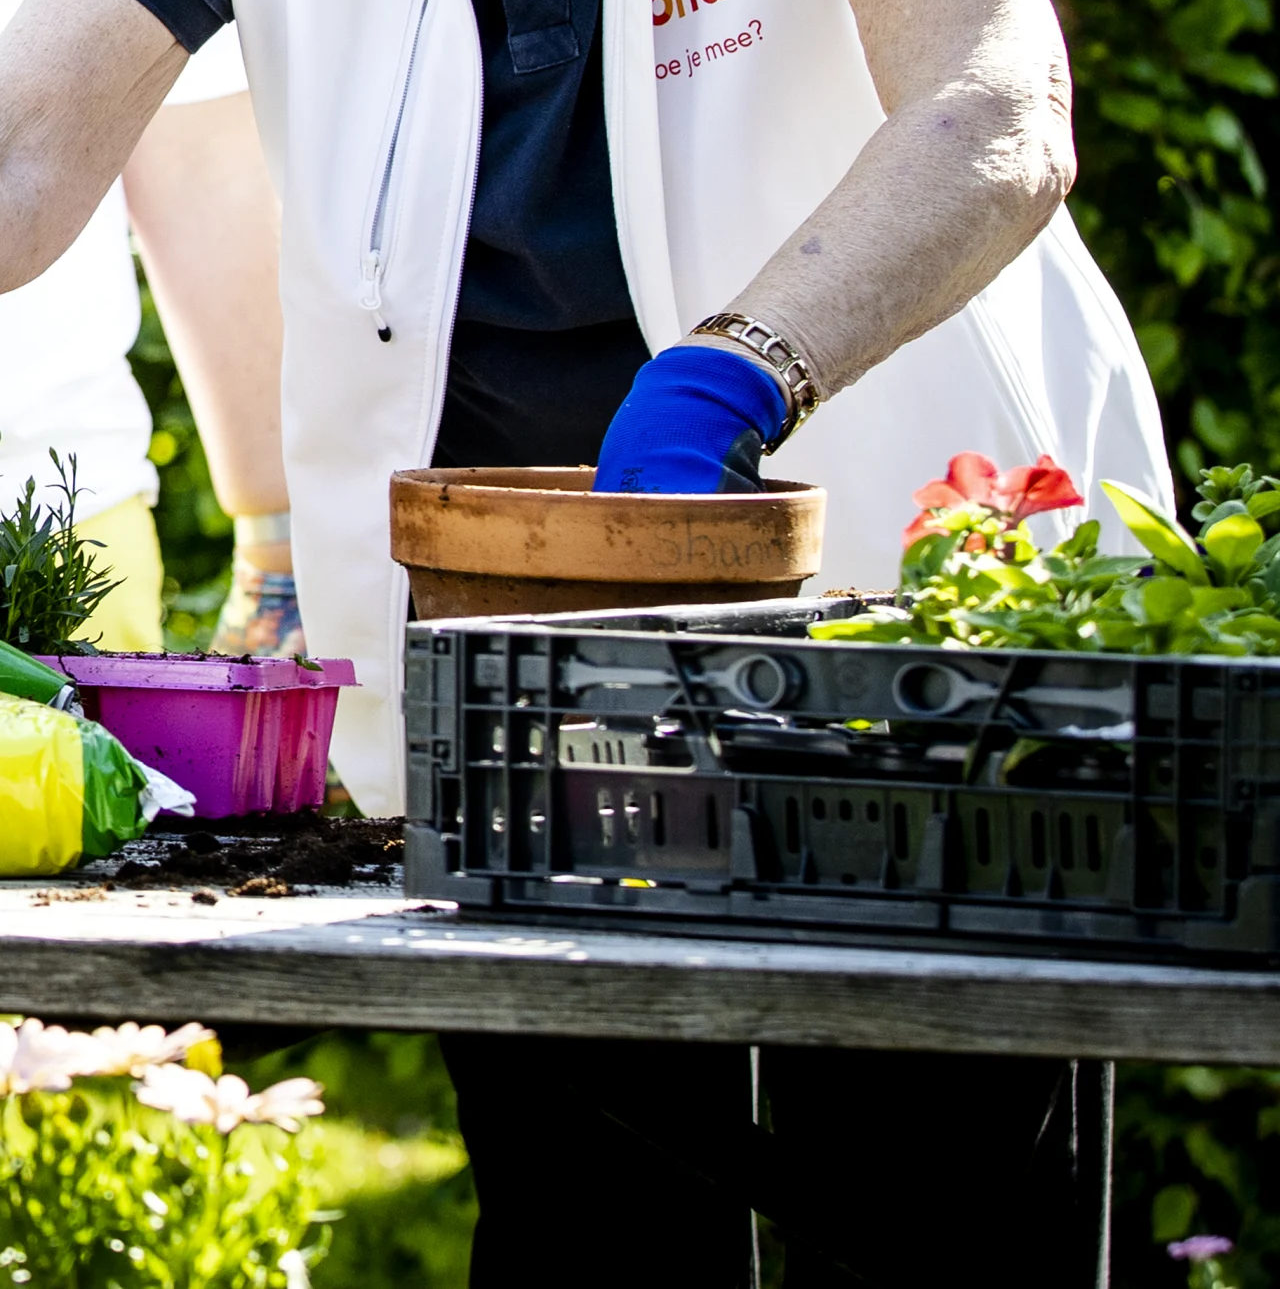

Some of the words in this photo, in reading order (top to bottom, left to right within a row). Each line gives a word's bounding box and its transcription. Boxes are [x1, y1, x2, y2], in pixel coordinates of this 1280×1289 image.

[655, 59, 682, 80] oe
[685, 48, 702, 77] je
[705, 19, 764, 62] mee?
